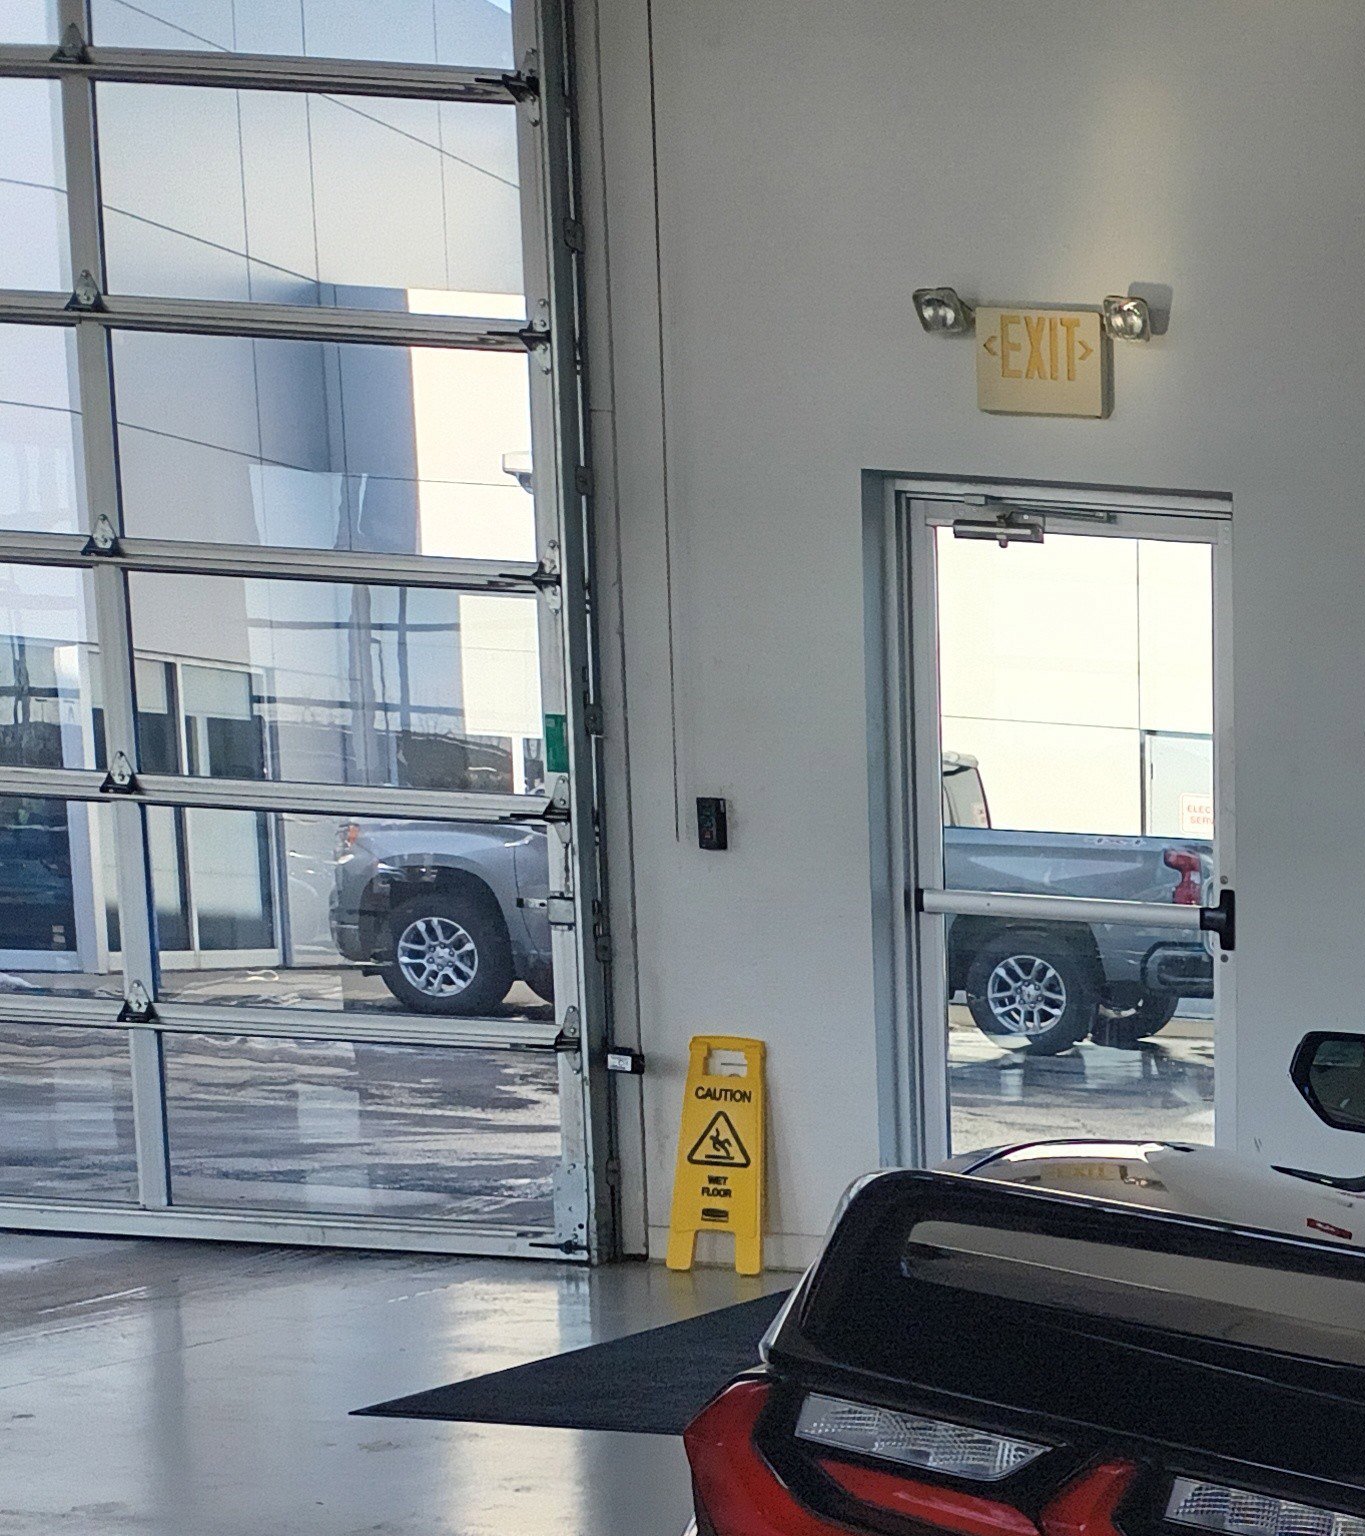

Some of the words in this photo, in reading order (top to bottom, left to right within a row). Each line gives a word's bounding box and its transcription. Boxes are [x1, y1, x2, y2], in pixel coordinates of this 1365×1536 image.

[1000, 315, 1081, 381] EXIT
[694, 1085, 752, 1103] CAUTION
[707, 1174, 729, 1186] WET
[701, 1186, 732, 1198] FLOOR
